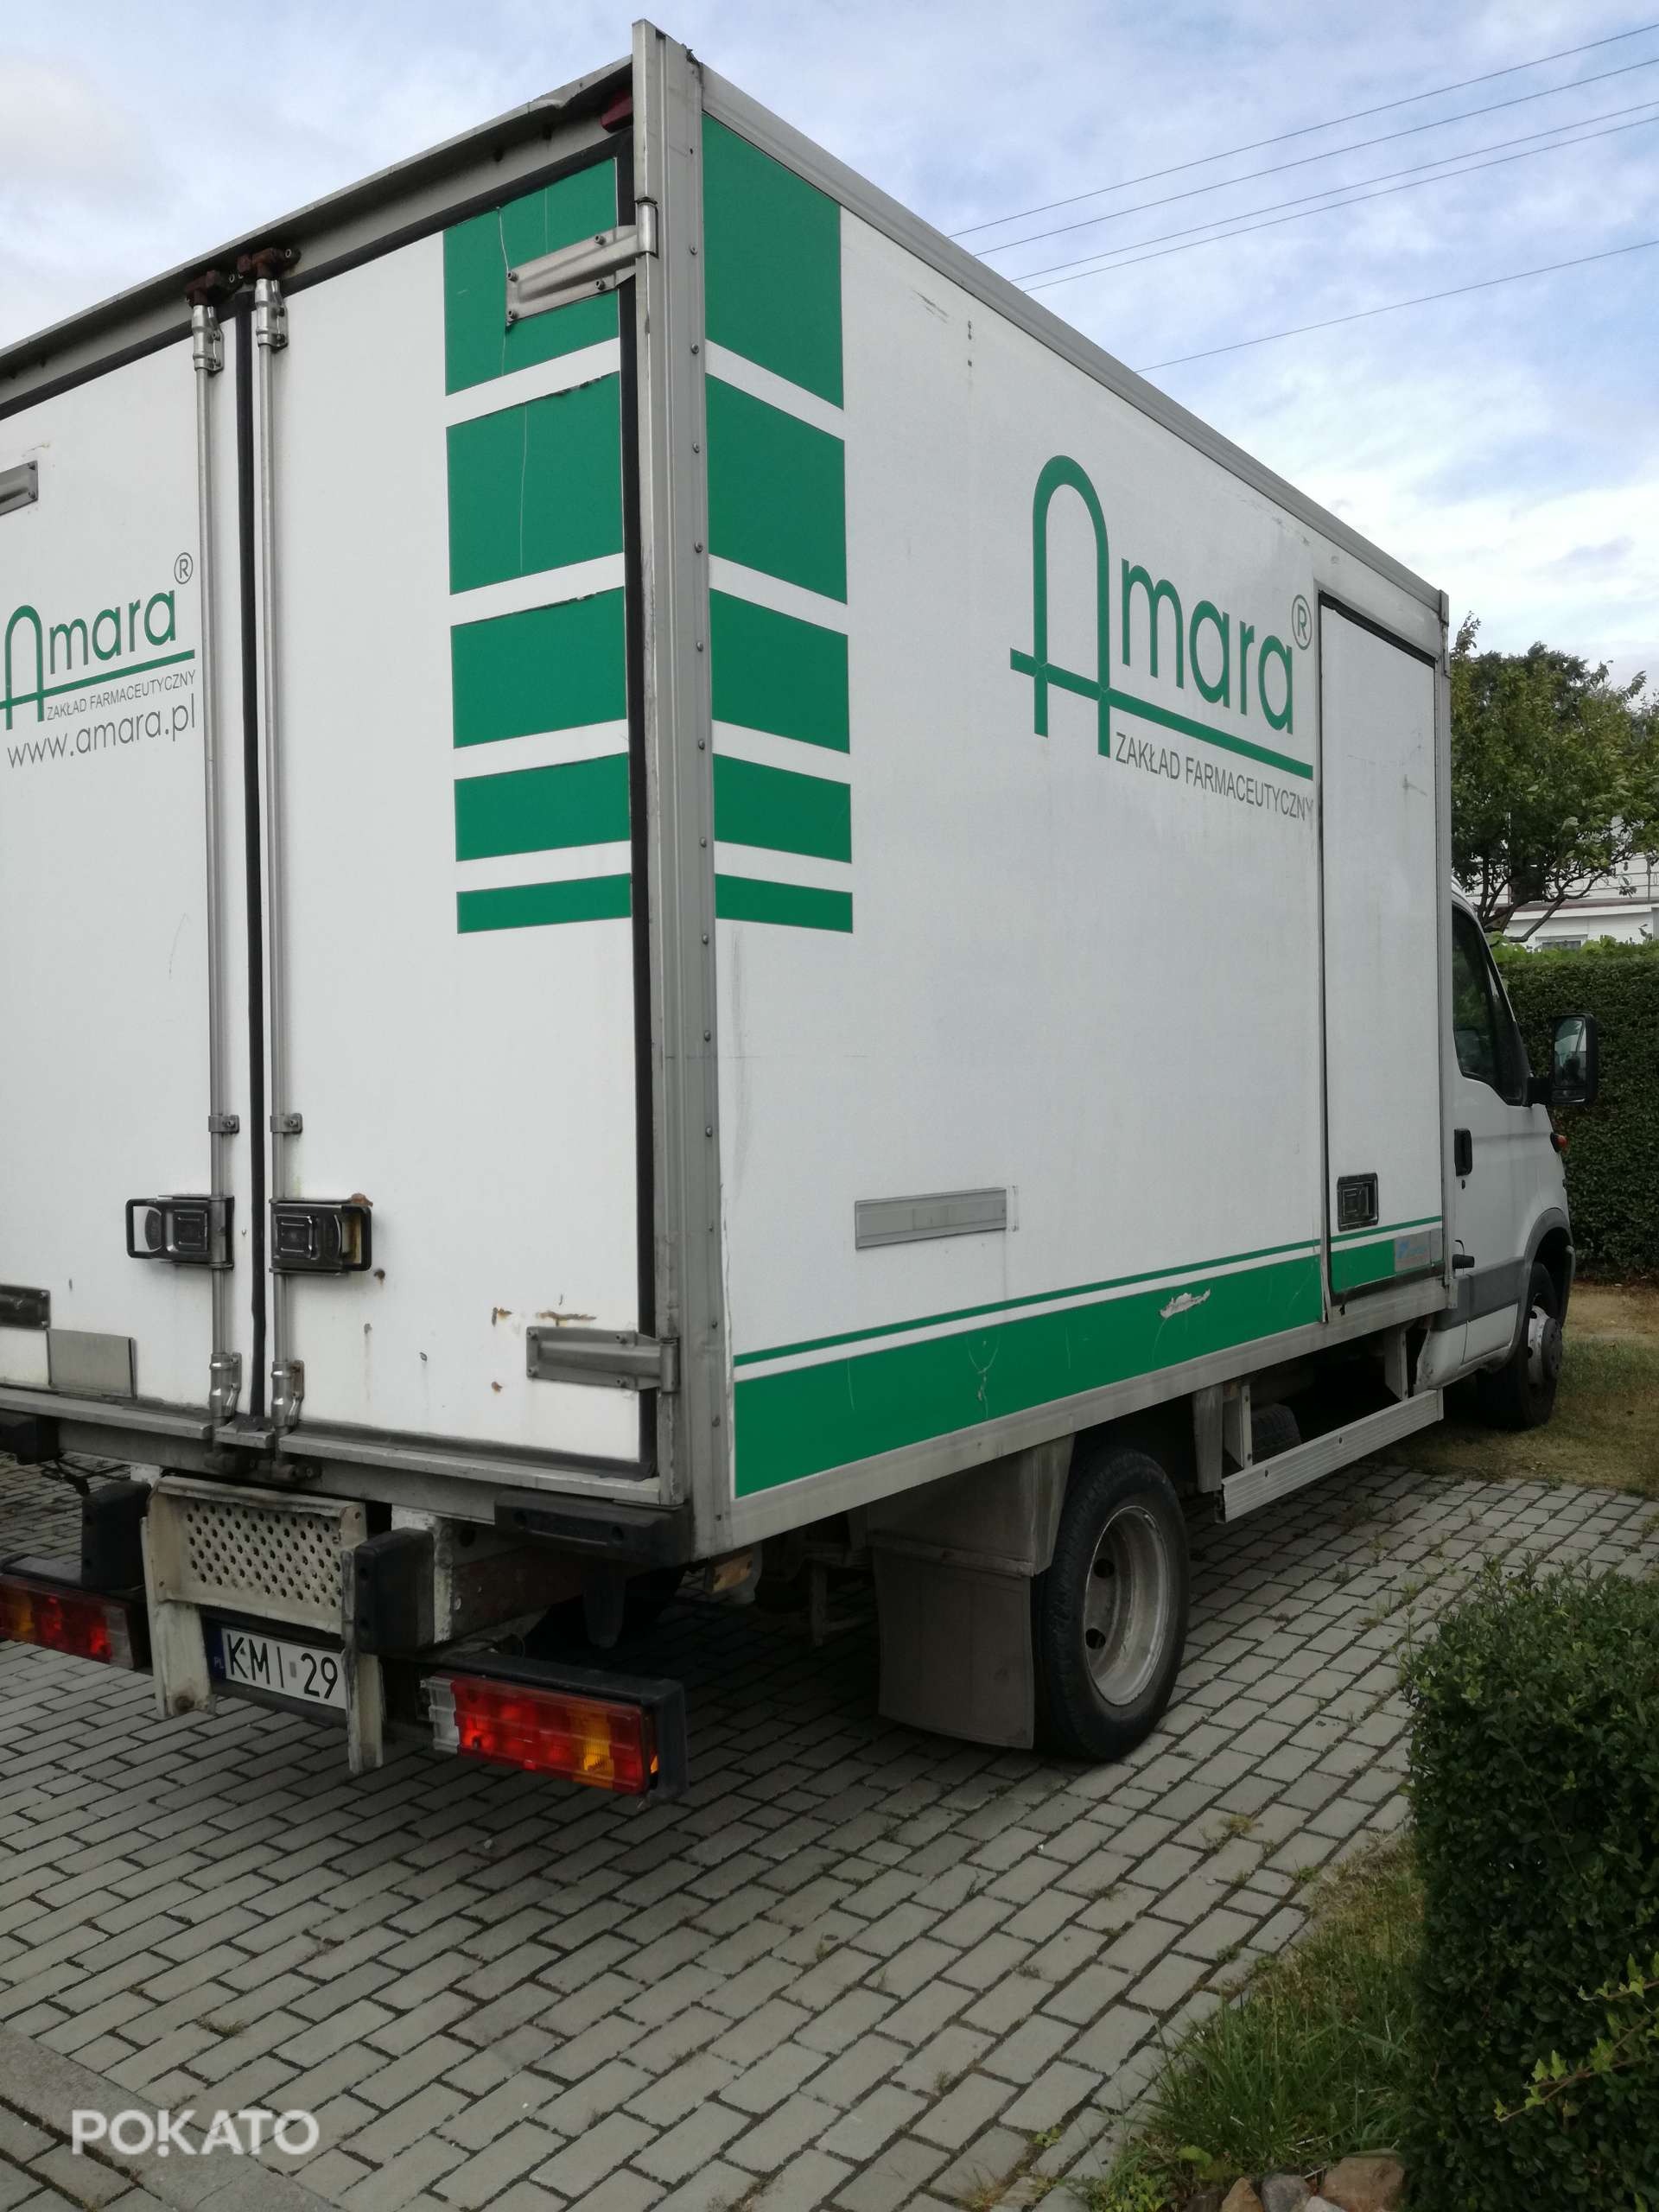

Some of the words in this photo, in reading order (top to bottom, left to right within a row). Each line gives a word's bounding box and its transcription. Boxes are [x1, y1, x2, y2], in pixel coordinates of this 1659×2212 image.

[1010, 454, 1294, 759] Amara
[4, 589, 177, 731] Amara
[47, 697, 87, 721] ZAKŁAD
[89, 669, 196, 711] FARMACEUTYCZNY
[7, 693, 196, 768] www.amara.pl
[1115, 731, 1181, 781] ZAKŁAD
[1185, 756, 1314, 830] FARMACEUTYCZNY
[226, 1632, 285, 1689] KMI
[300, 1651, 339, 1700] 29
